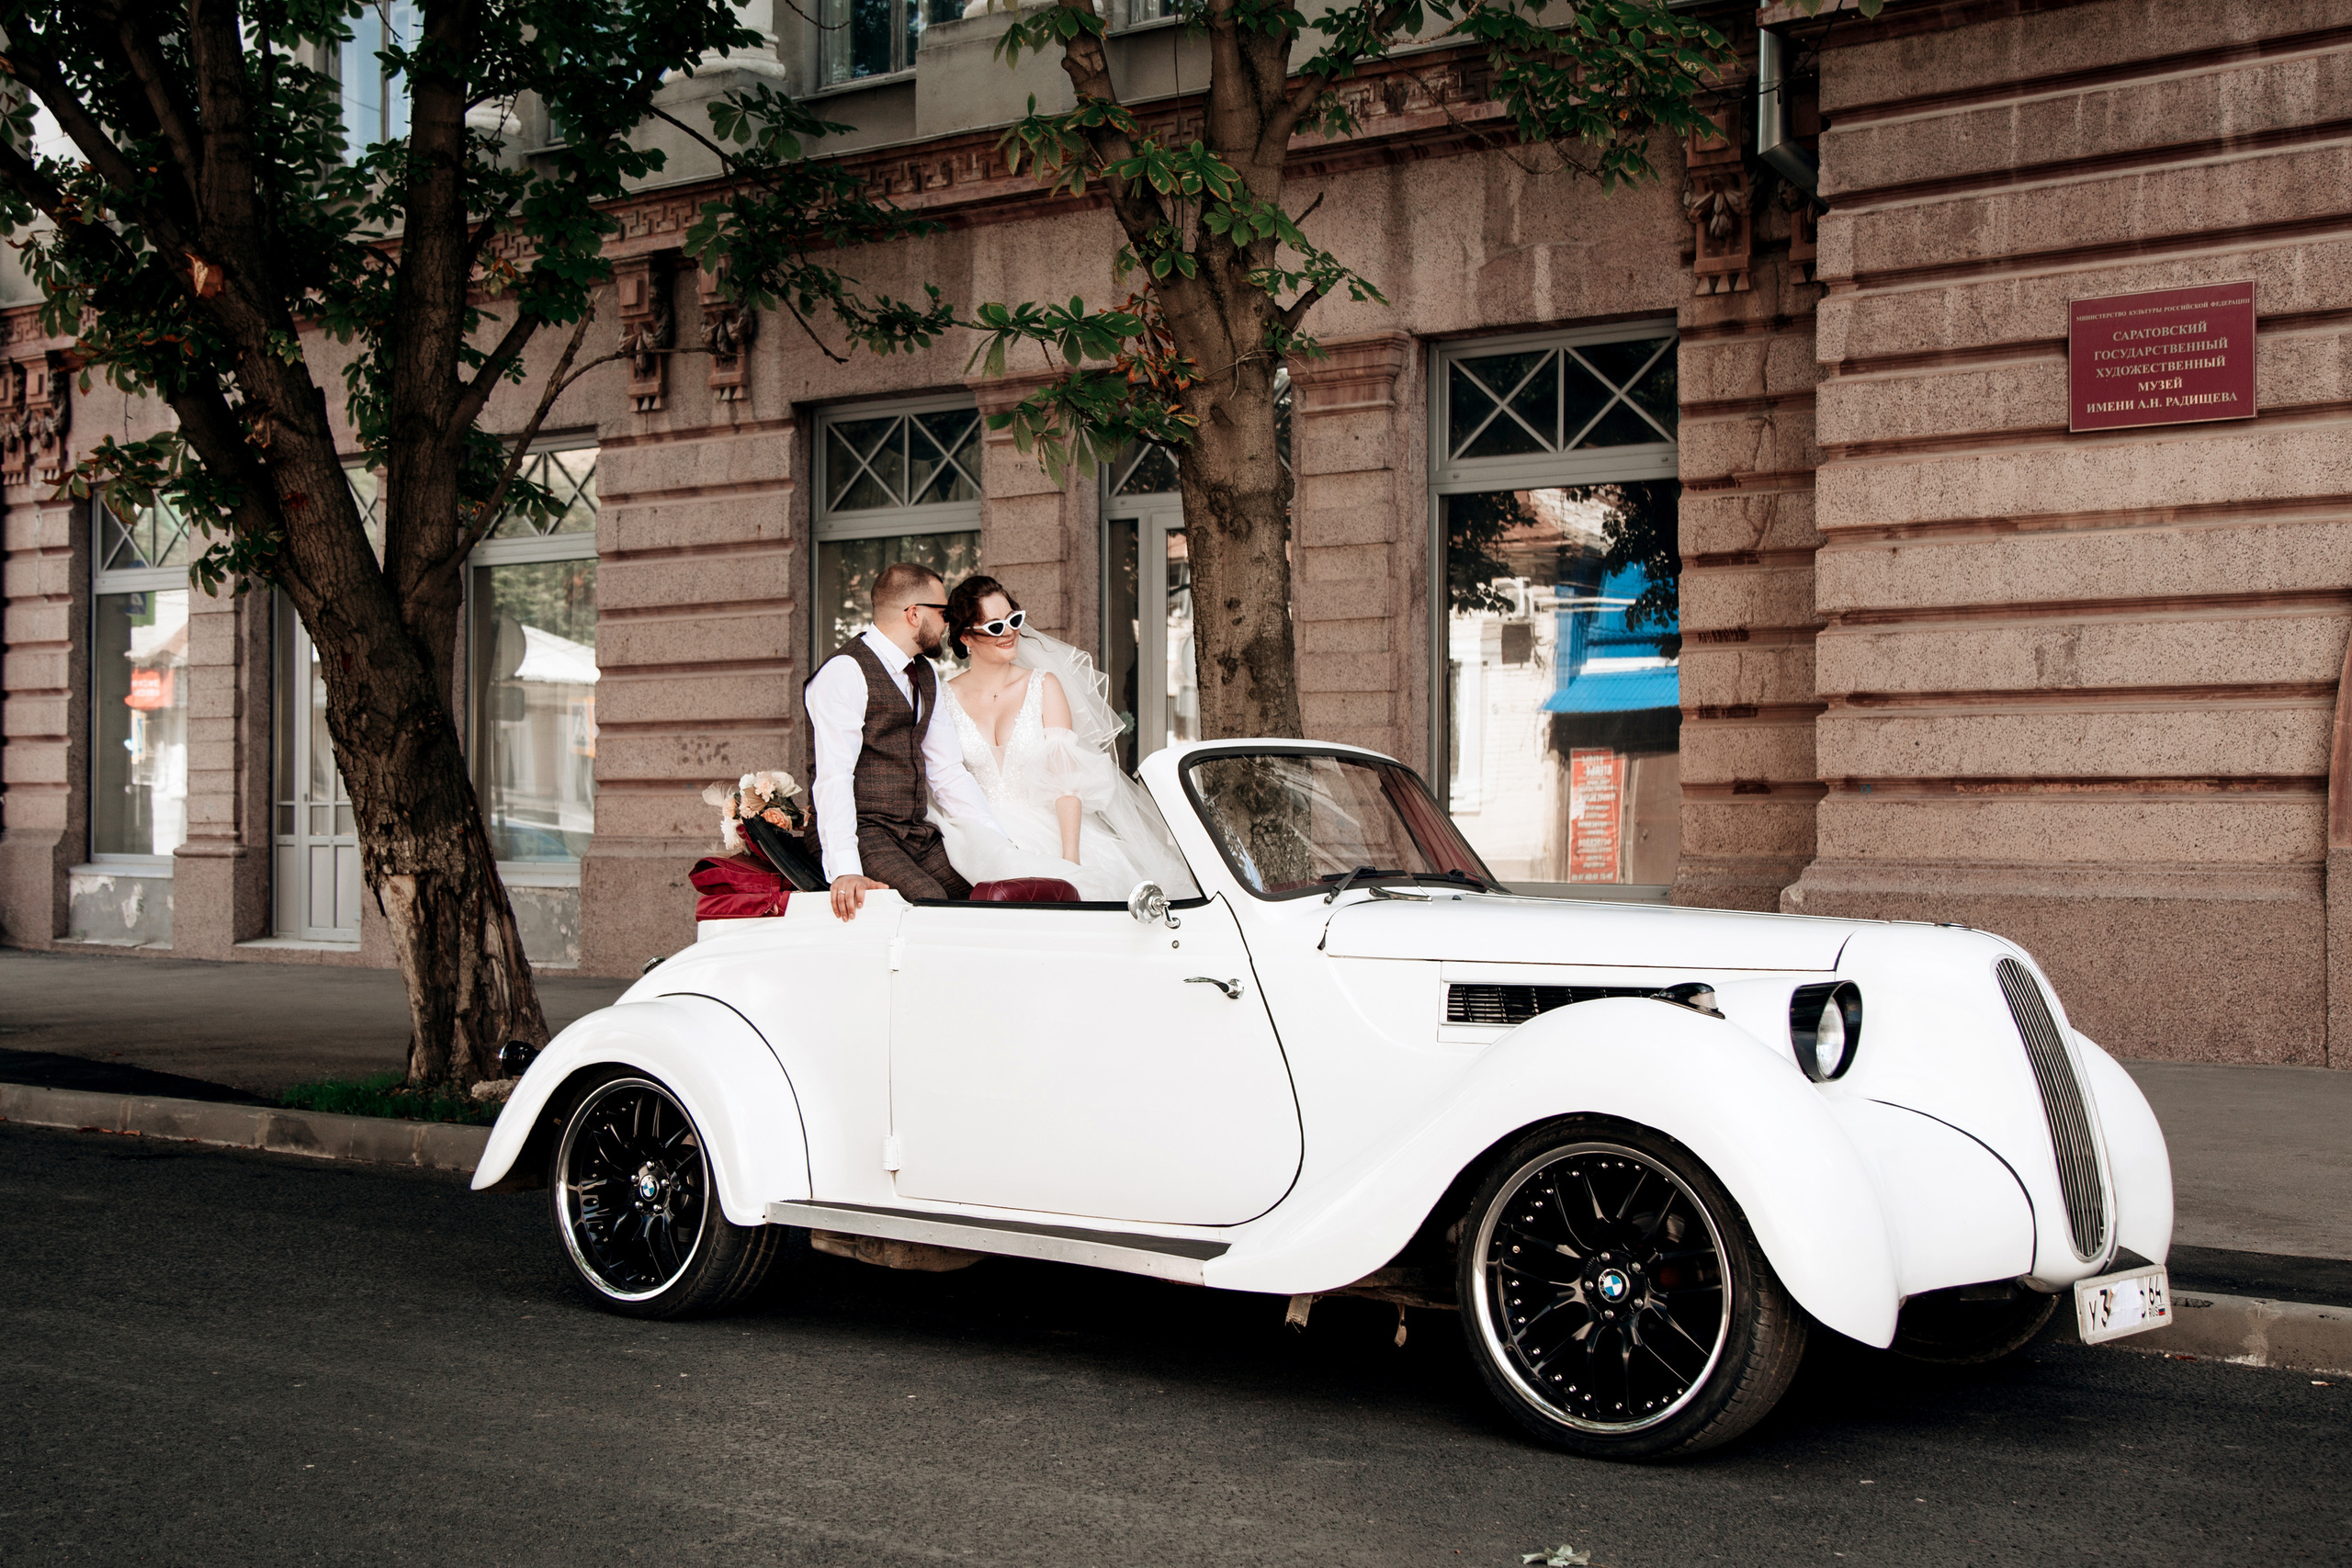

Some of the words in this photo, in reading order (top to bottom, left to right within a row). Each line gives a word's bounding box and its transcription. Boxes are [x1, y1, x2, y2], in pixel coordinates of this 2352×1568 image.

[2076, 310, 2127, 321] МИНИСТЕРСТВО
[2129, 307, 2163, 317] КУЛЬТУРЫ
[2164, 301, 2209, 312] РОССИЙСКОЙ
[2210, 298, 2251, 308] ФЕДЕРАЦИИ
[2112, 321, 2207, 342] САРАТОВСКИЙ
[2094, 336, 2228, 361] ГОСУДАРСТВЕННЫЙ
[2096, 355, 2226, 378] ХУДОЖЕСТВЕННЫЙ
[2137, 377, 2183, 392] МУЗЕЙ
[2086, 400, 2134, 413] ИМЕНИ
[2137, 398, 2163, 409] А.Н.
[2165, 391, 2238, 407] РАДИЩЕВА
[2148, 1276, 2163, 1305] 64
